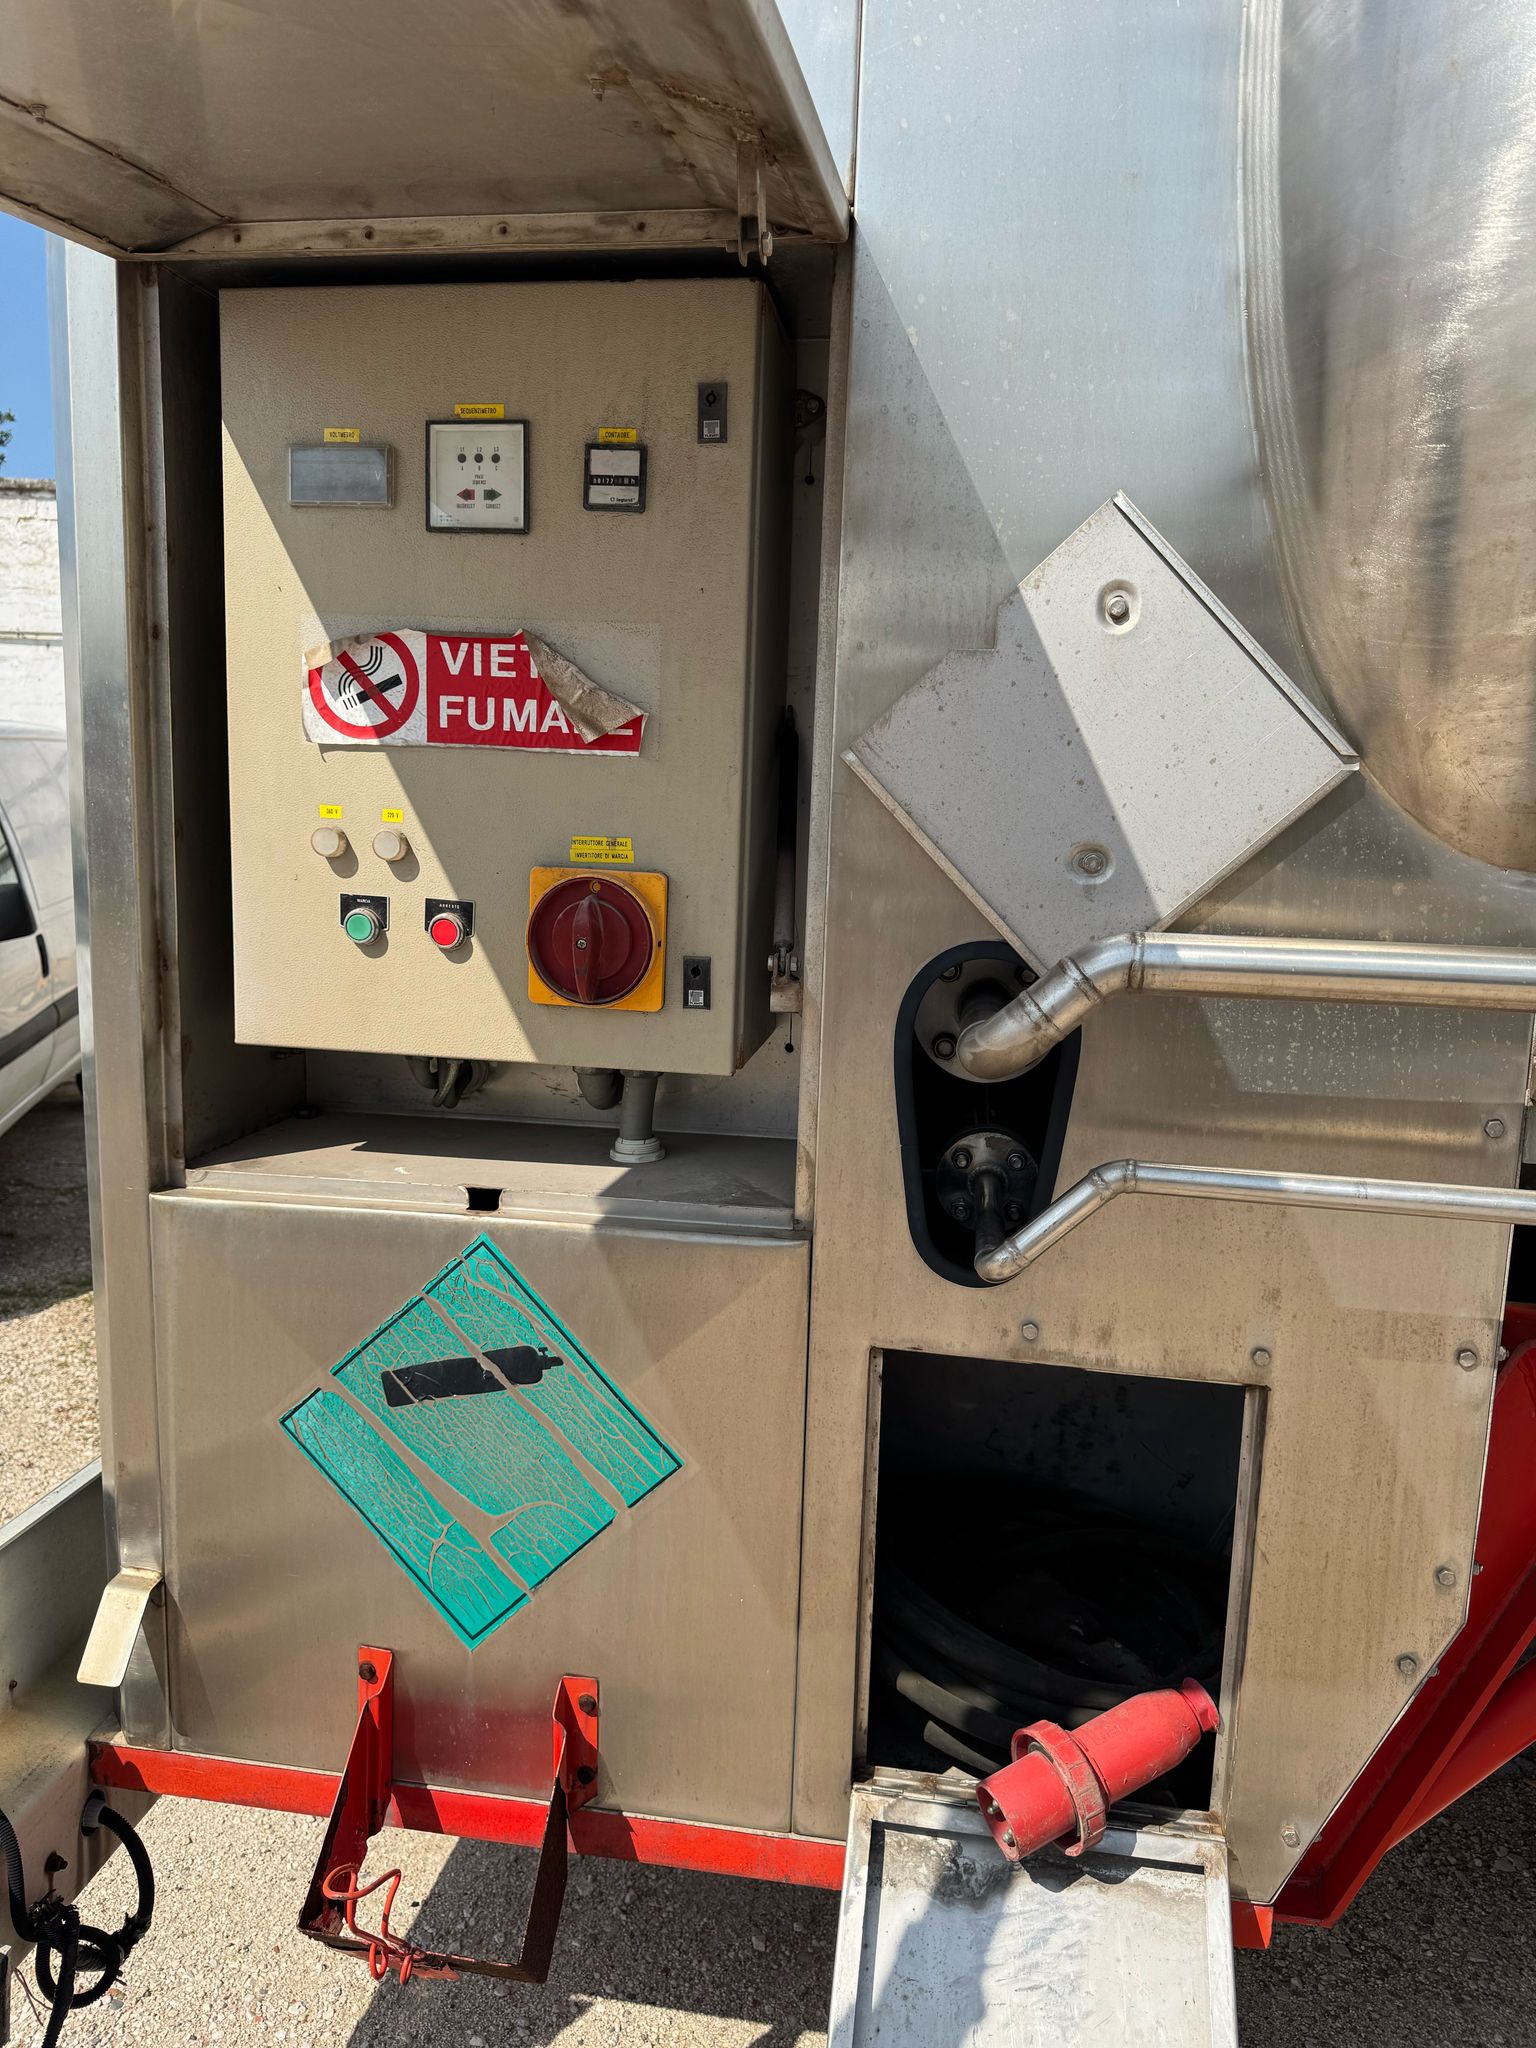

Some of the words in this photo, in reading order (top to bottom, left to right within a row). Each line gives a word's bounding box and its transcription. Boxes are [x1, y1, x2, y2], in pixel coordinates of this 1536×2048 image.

[460, 407, 497, 415] SEQUENZIMETRO
[374, 470, 382, 481] V
[440, 641, 540, 679] VIET
[439, 695, 633, 736] FUMA
